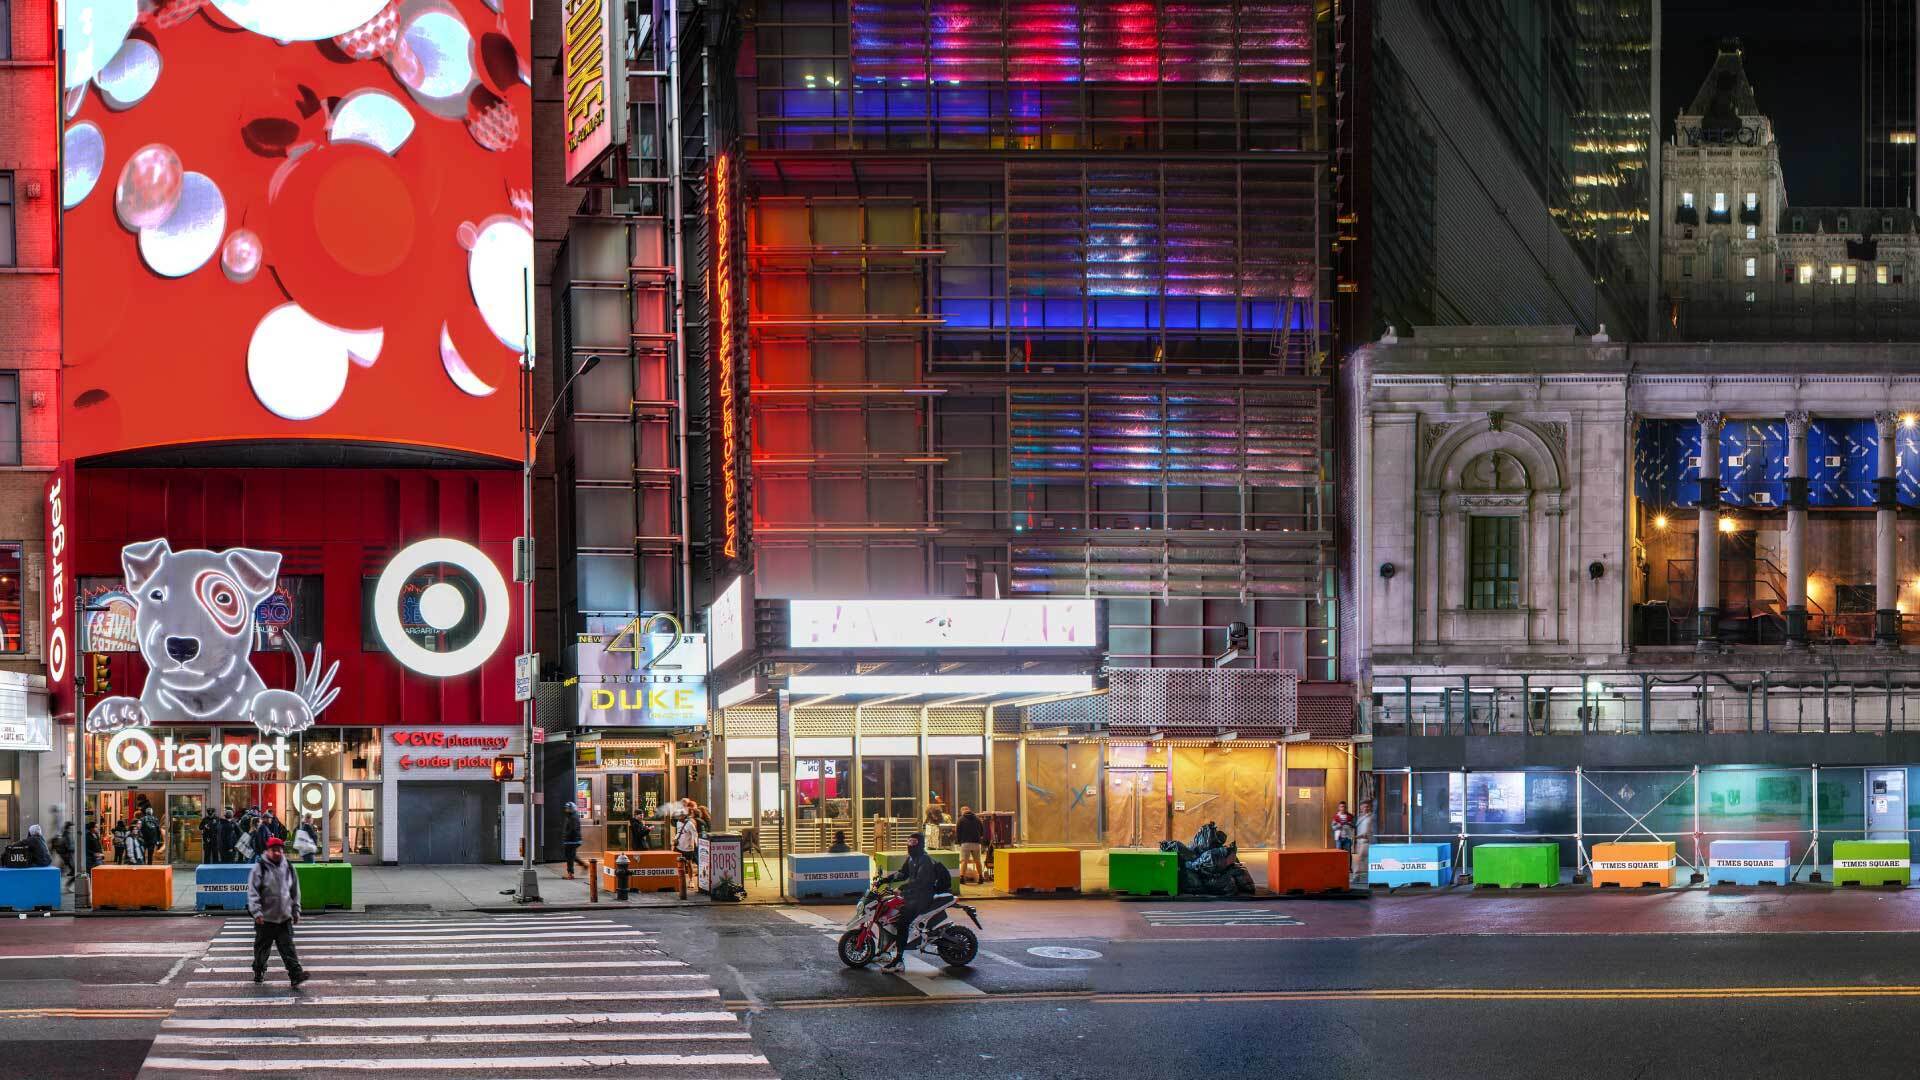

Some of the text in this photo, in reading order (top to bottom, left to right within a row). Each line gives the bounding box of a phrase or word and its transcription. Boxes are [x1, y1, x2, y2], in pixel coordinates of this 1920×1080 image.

[49, 477, 65, 625] target
[579, 635, 602, 643] NEW
[604, 613, 683, 671] 42
[601, 674, 684, 683] STUDIOS
[591, 689, 694, 710] DUKE
[410, 732, 509, 749] CVS pharmacy
[160, 737, 290, 781] target
[416, 755, 494, 771] order picku
[646, 868, 675, 876] SQUARE
[1400, 863, 1427, 871] QUARE
[1627, 861, 1659, 869] SQUARE
[829, 872, 859, 880] SQUARE
